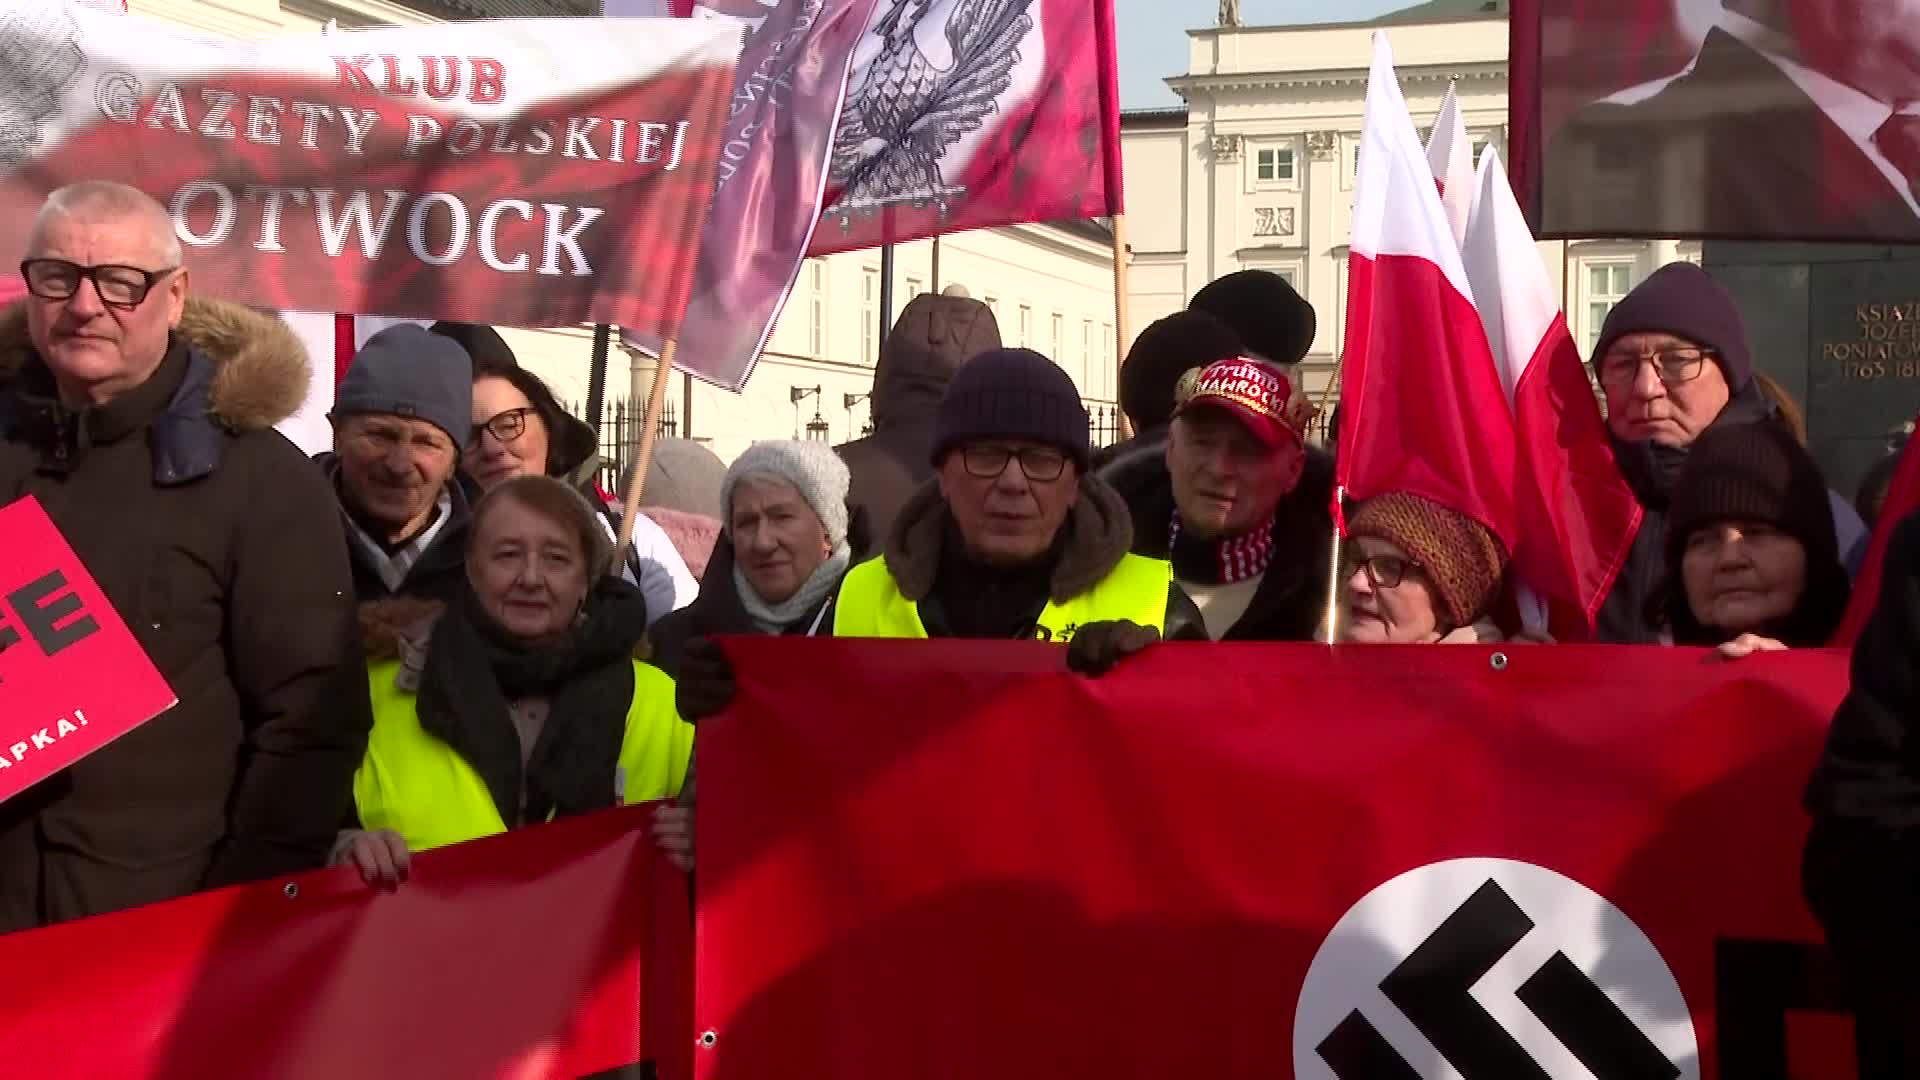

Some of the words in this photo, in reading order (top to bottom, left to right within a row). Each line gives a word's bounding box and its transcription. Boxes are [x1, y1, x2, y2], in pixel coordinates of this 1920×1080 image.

[95, 71, 381, 154] GAZETY
[404, 112, 690, 170] POLSKIEJ
[331, 54, 507, 104] KLUB
[170, 180, 605, 276] OTWOCK
